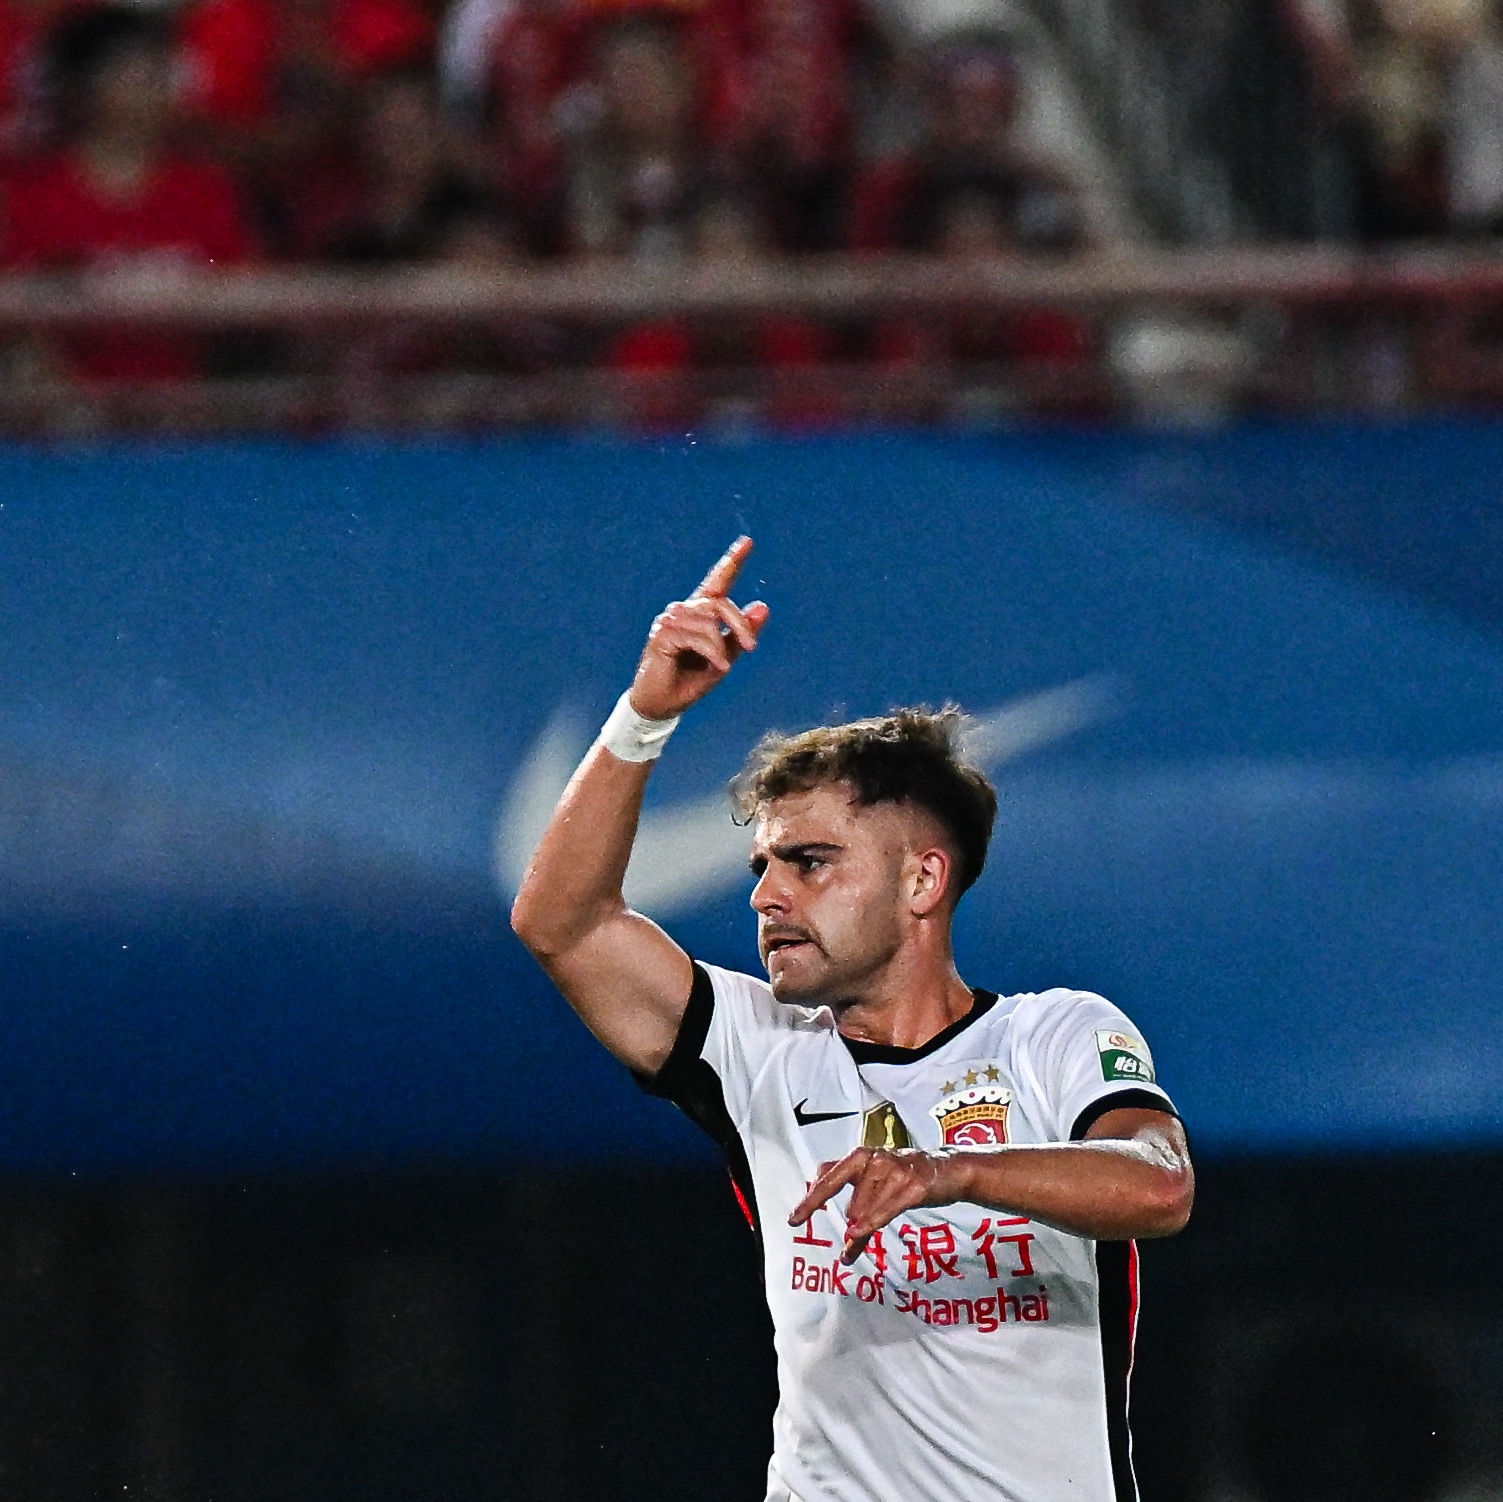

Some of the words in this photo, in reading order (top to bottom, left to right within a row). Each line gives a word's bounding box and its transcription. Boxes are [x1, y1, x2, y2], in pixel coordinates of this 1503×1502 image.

[791, 1256, 852, 1296] Bank
[855, 1268, 886, 1305] of
[894, 1285, 1050, 1333] Shanghai
